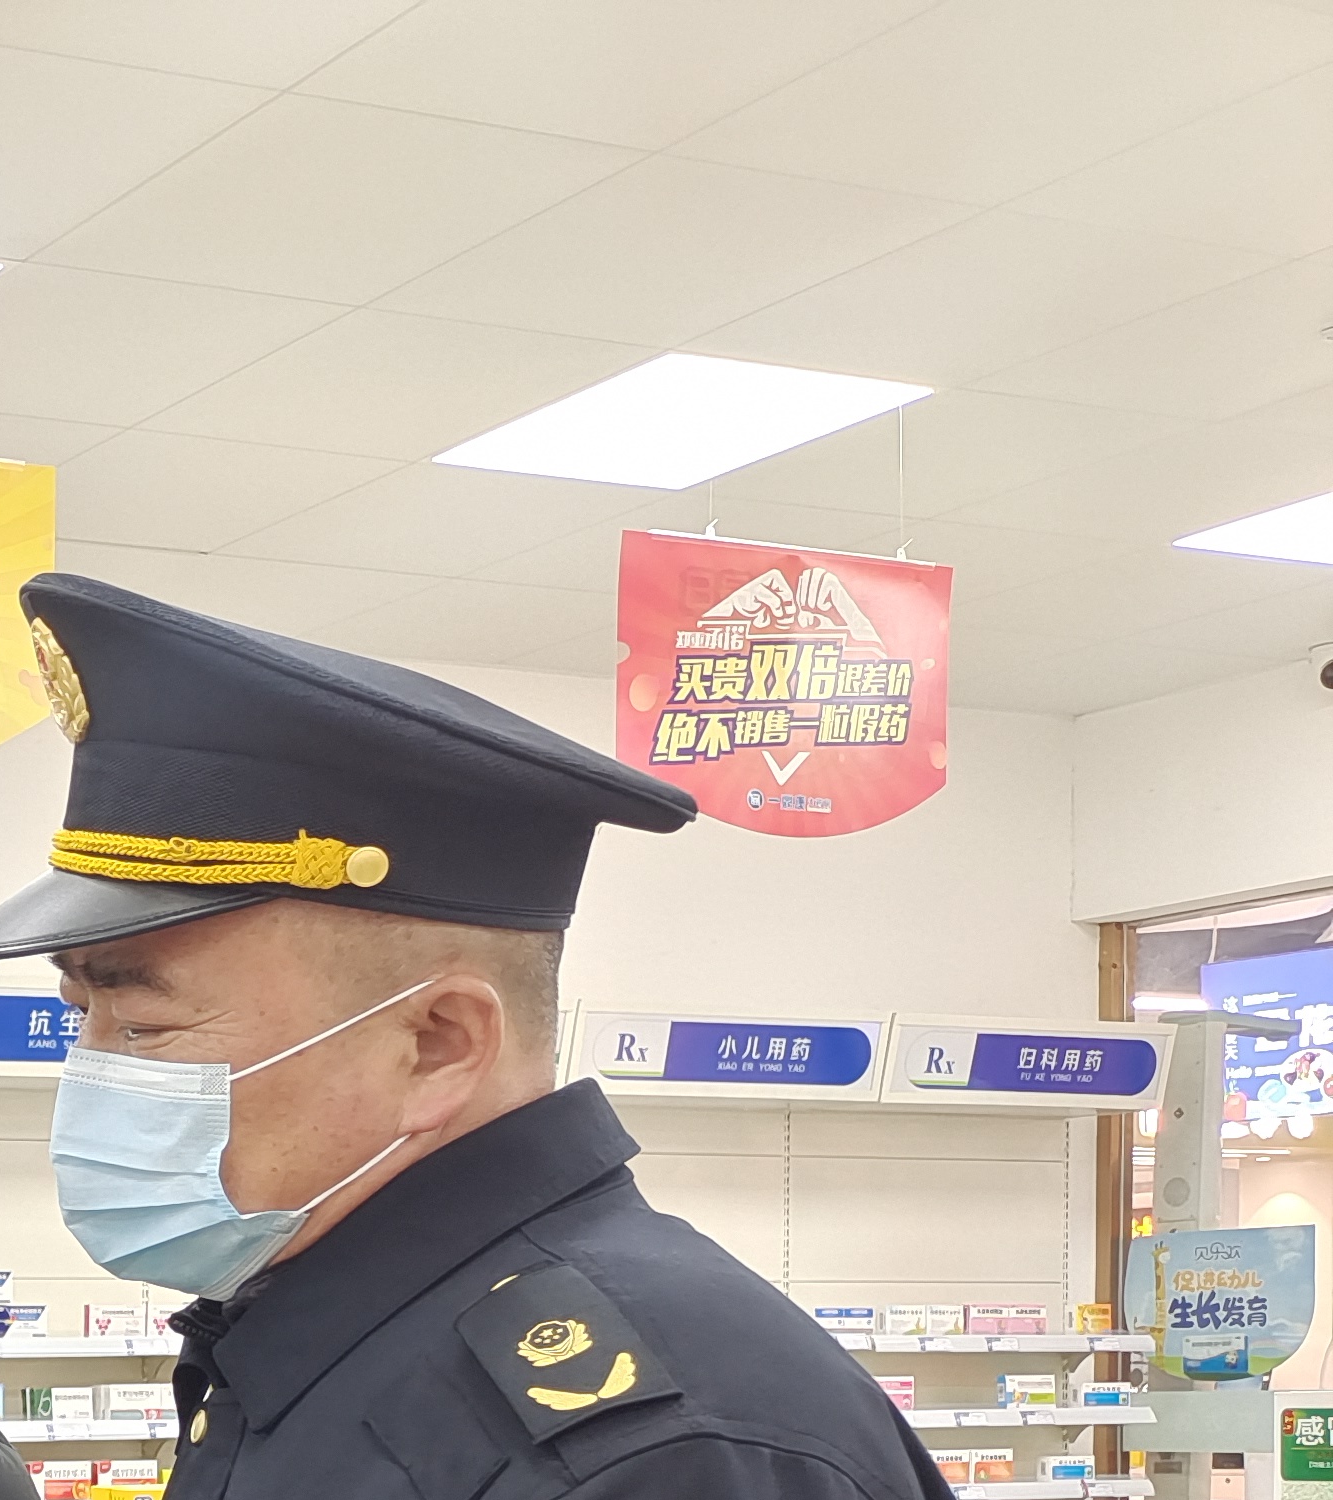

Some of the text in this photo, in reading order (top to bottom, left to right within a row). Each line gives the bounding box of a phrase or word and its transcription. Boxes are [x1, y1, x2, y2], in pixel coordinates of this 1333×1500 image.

[673, 643, 913, 702] 买贵双倍退差价
[651, 703, 910, 764] 绝不销售一粒假药
[613, 1032, 648, 1063] Rx
[717, 1035, 813, 1062] 小儿用药
[924, 1047, 956, 1075] Rx
[1168, 1289, 1268, 1330] 生长发育
